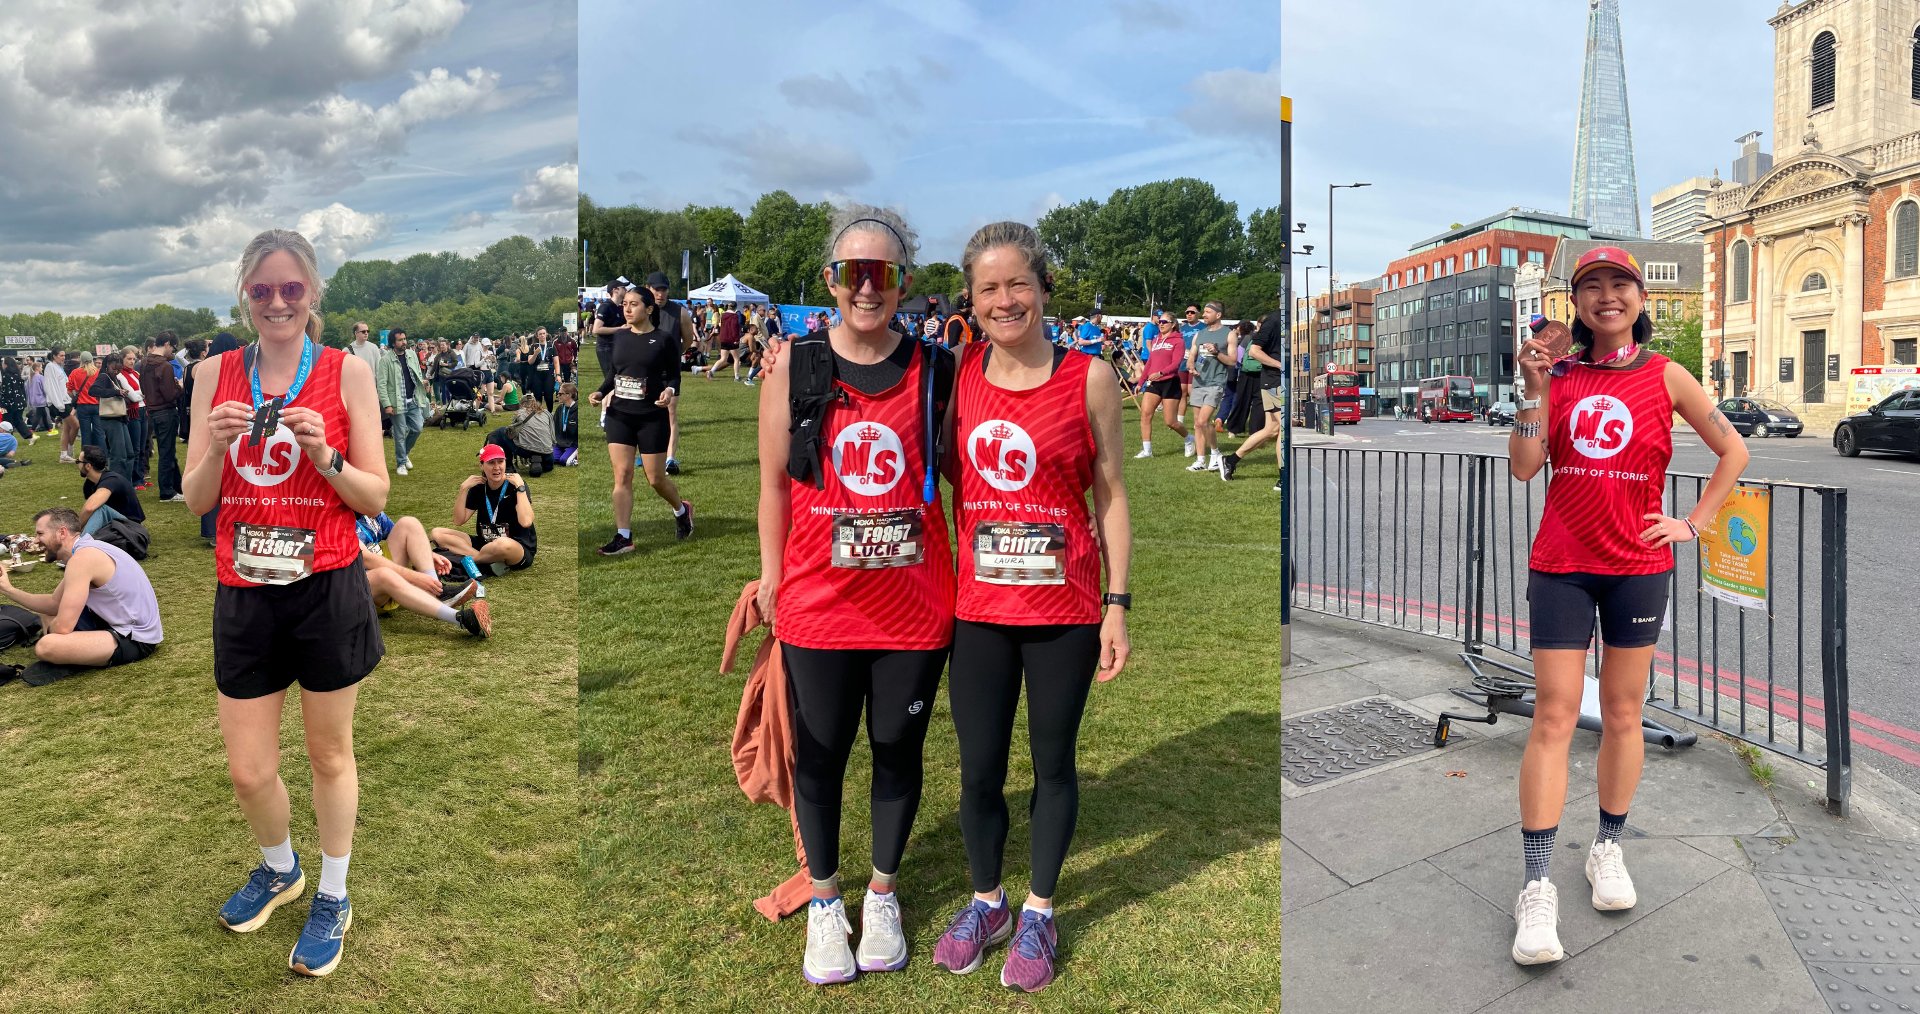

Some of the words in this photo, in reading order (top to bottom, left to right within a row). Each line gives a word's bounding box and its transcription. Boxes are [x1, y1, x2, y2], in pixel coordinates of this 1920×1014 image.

[1554, 466, 1587, 476] MISTRY
[1590, 469, 1605, 477] OF
[1608, 471, 1649, 481] STORIES
[221, 496, 258, 506] INISTRY
[262, 497, 277, 506] OF
[281, 497, 325, 506] STORIES
[1005, 502, 1020, 512] OF
[853, 518, 874, 526] HOKA
[246, 529, 264, 537] HOKA
[862, 523, 912, 544] F9857
[249, 537, 305, 557] F13867
[998, 535, 1051, 554] C11177
[850, 543, 901, 558] LUCIE
[994, 557, 1025, 565] LAURA
[1732, 560, 1747, 568] TASKS
[1717, 569, 1735, 577] receive
[1739, 574, 1753, 582] prize
[1730, 566, 1749, 575] stamps
[1723, 579, 1739, 589] Garden
